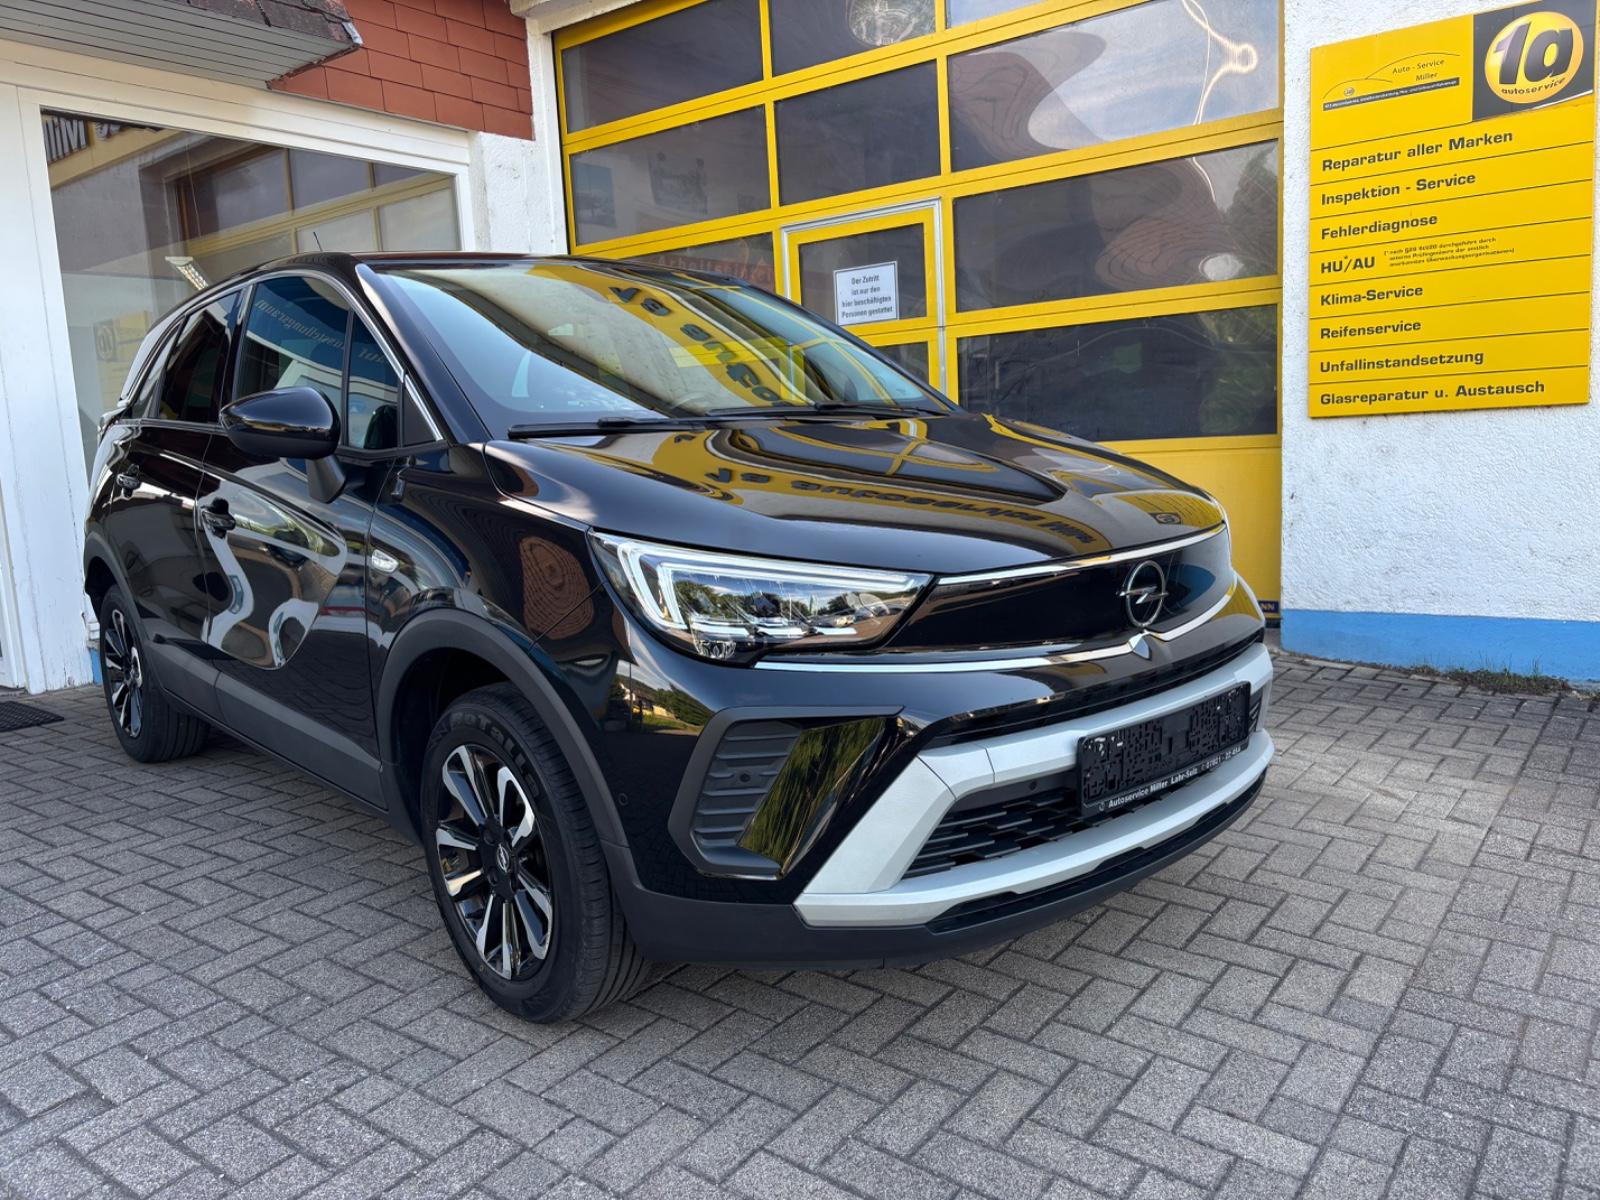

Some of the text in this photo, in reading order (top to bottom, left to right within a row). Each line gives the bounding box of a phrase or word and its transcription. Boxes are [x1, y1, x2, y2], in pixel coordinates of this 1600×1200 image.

[1492, 22, 1573, 85] 1a
[1391, 63, 1410, 75] Auto
[1416, 58, 1445, 71] Service
[1415, 71, 1439, 82] Miller
[1501, 76, 1566, 96] autoservice
[1321, 131, 1514, 172] Reparatur aller Marken
[1321, 184, 1401, 206] Inspektion
[1415, 172, 1476, 192] Service
[1320, 215, 1438, 240] Fehlerdiagnose
[851, 274, 880, 285] Der Zutritt
[841, 300, 853, 308] hier
[1320, 285, 1424, 306] Klima-Service
[841, 306, 893, 318] Personen gestattet
[1320, 320, 1422, 340] Reifenservice
[1319, 352, 1485, 373] Unfallinstandsetzung
[1320, 381, 1546, 405] Glasreparatur u. Austausch
[1108, 788, 1149, 808] Autoservice
[1150, 781, 1169, 793] Miller
